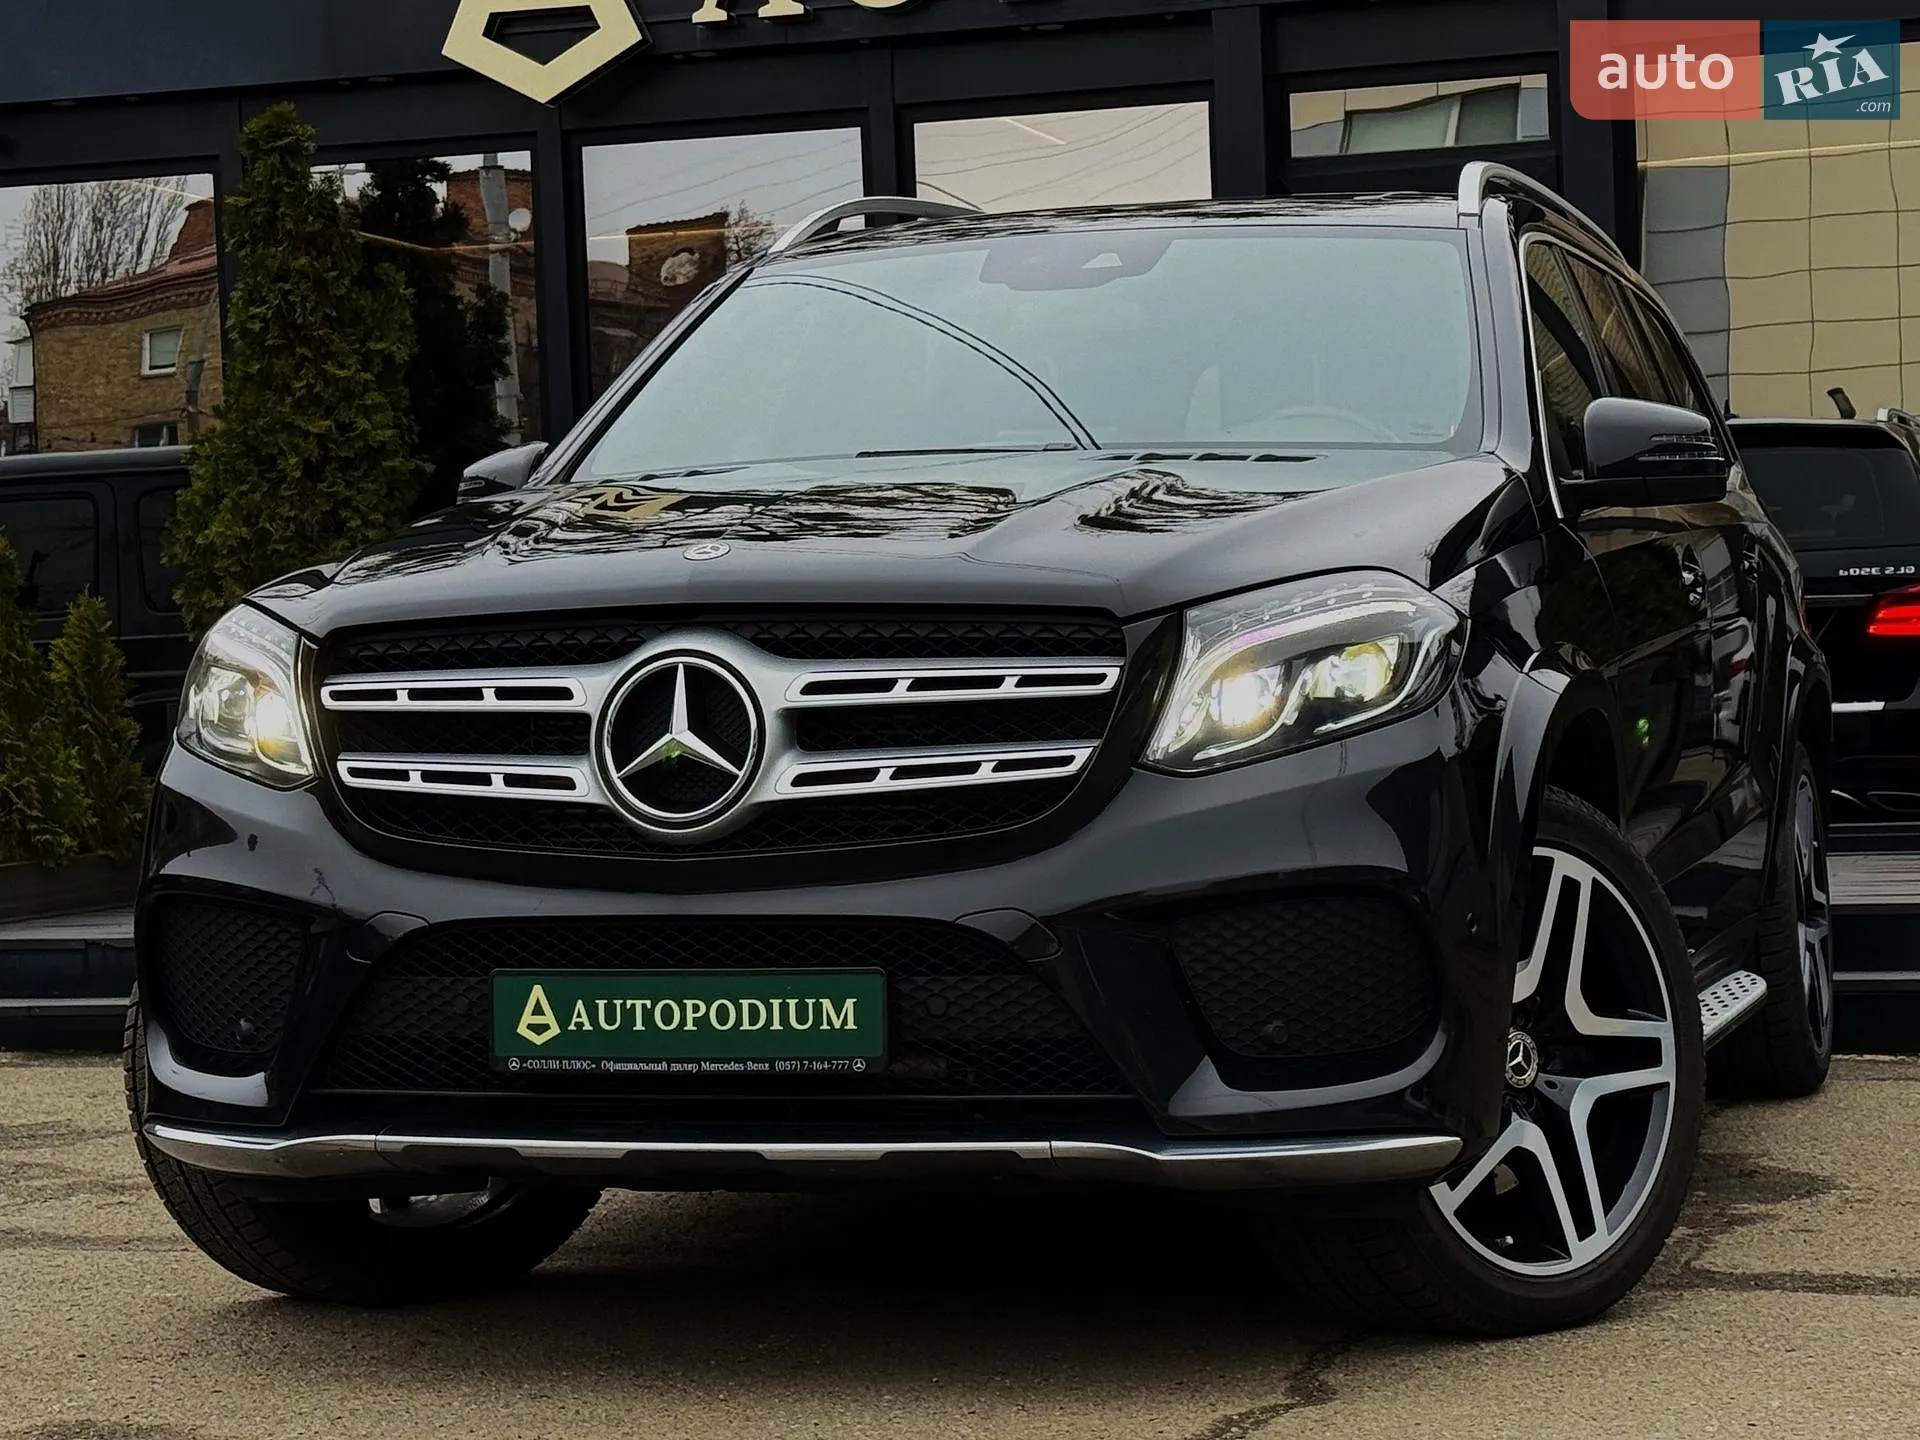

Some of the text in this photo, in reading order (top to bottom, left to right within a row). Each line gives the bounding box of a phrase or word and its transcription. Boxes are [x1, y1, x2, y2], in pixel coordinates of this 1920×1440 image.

[567, 999, 857, 1031] AUTOPODIUM
[601, 1061, 668, 1072] Официальный
[670, 1062, 699, 1073] дилер
[701, 1061, 770, 1071] Mercedes-Benz
[775, 1060, 801, 1072] (057)
